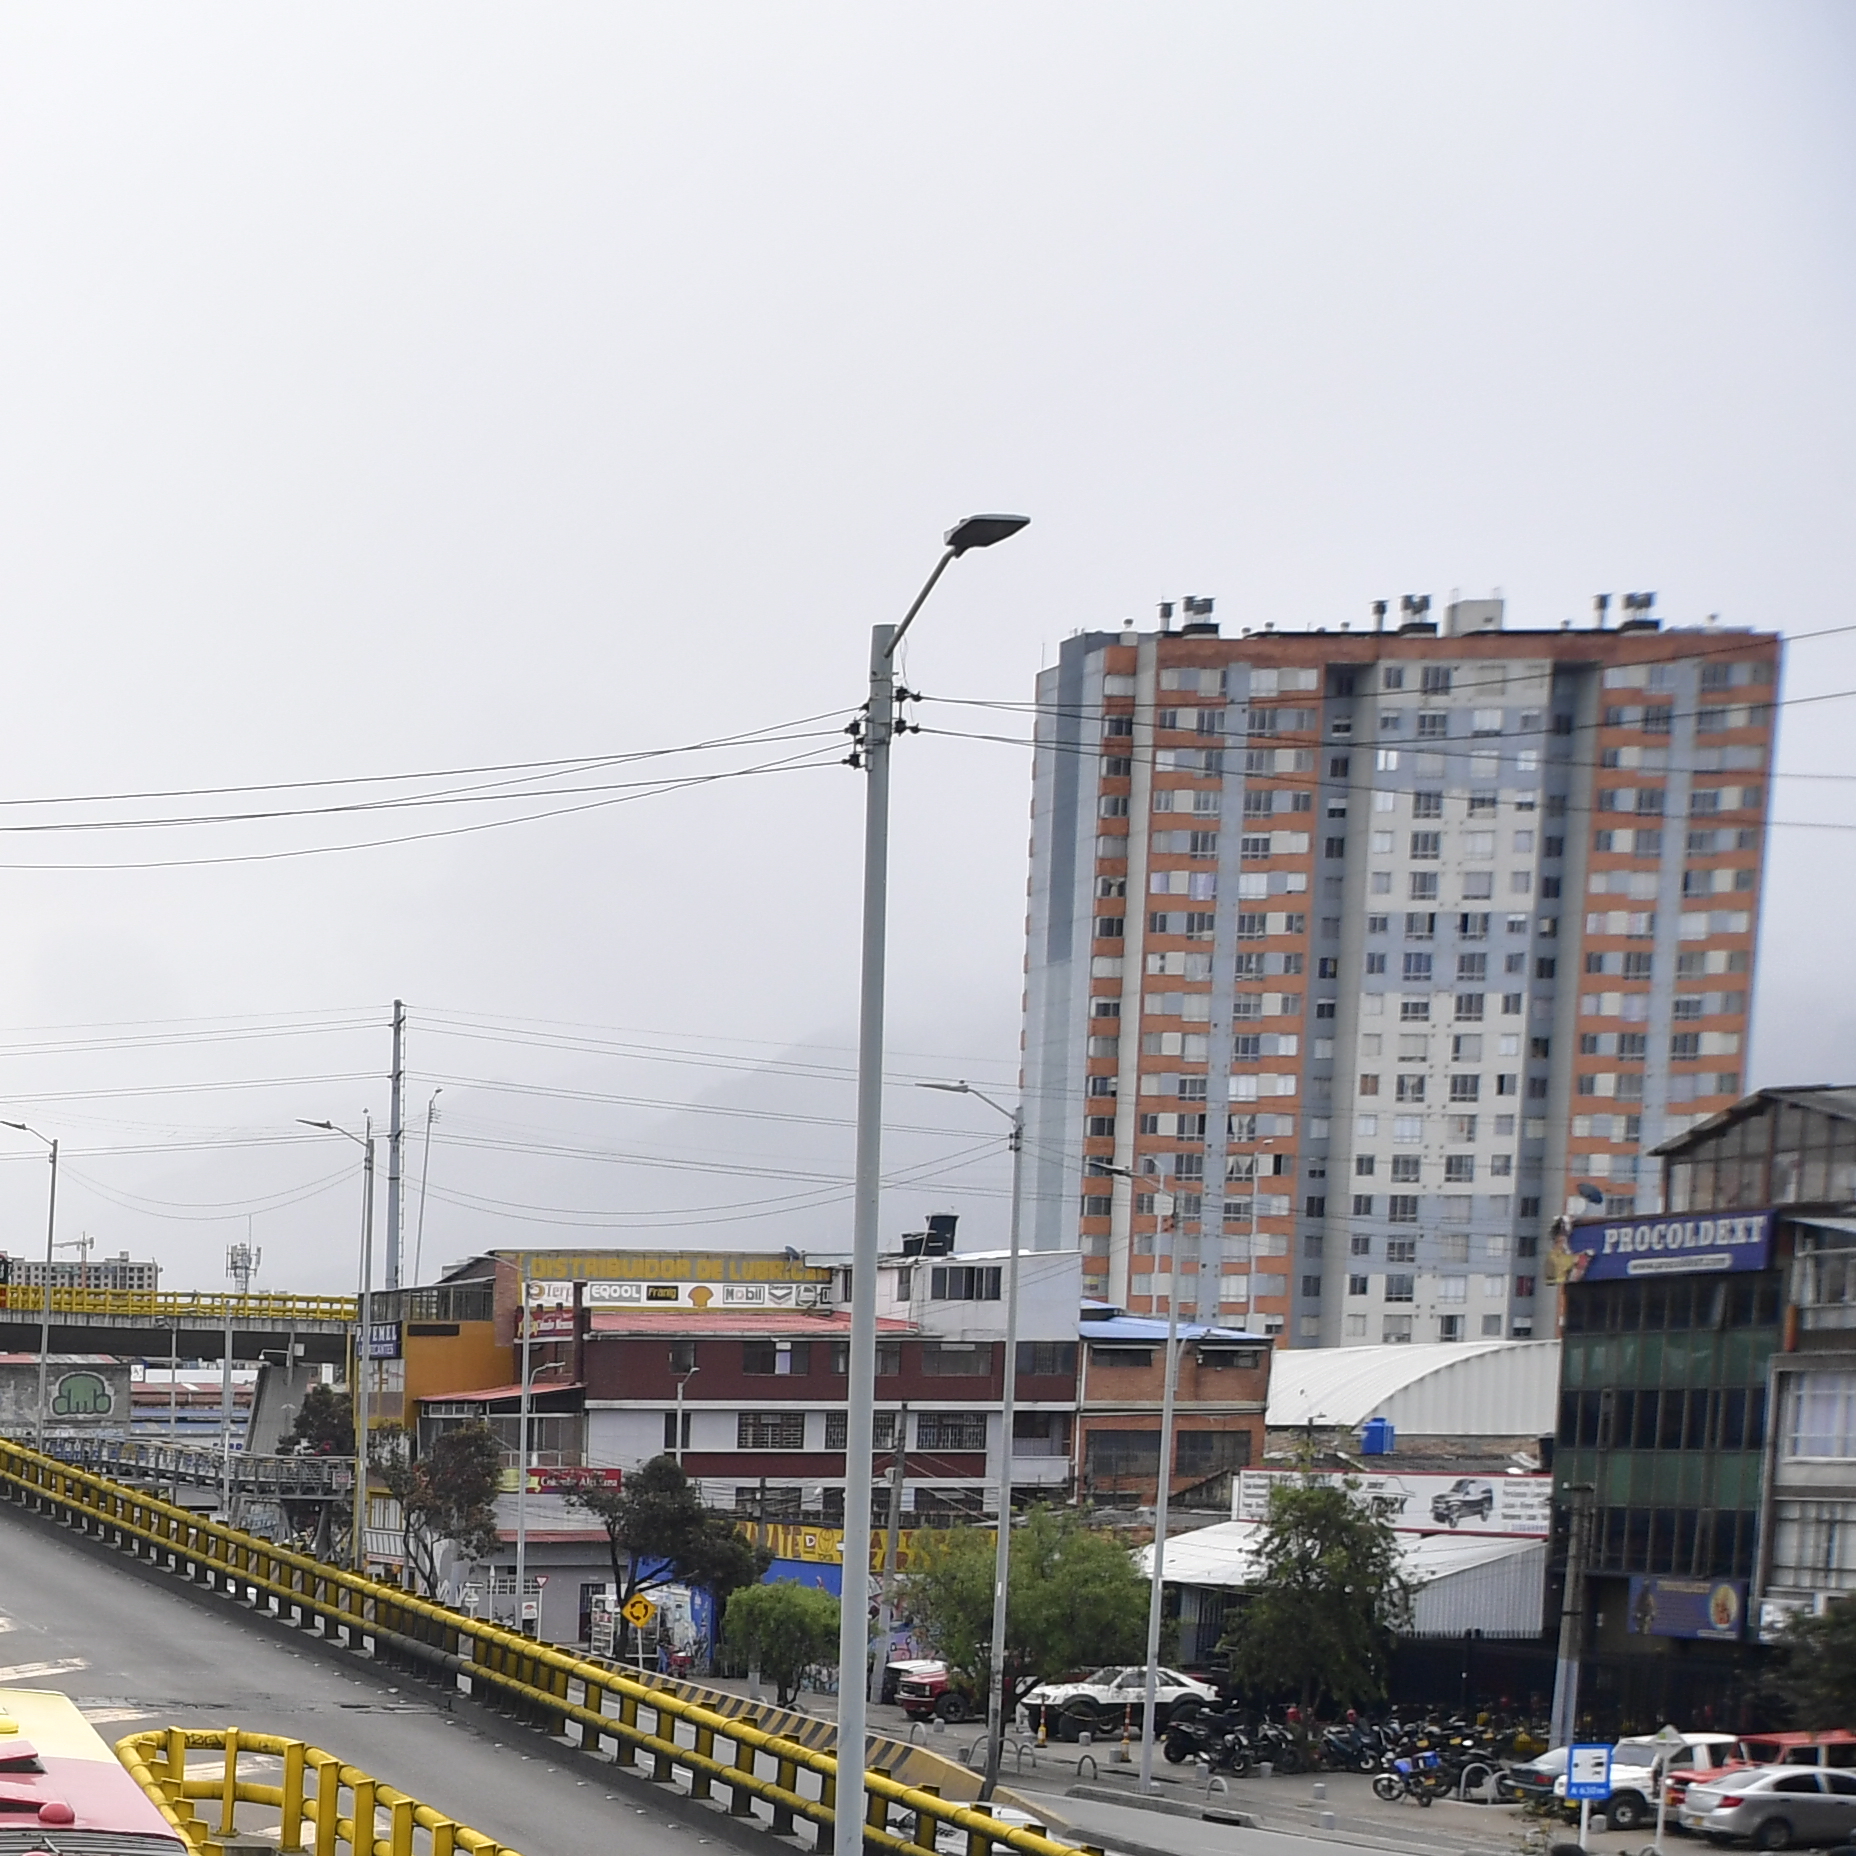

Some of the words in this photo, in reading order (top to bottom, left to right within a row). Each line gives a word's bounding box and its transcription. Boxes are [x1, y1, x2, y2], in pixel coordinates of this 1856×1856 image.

[531, 1257, 691, 1279] DISTRIBUIDOR
[697, 1258, 723, 1279] DE
[725, 1287, 762, 1302] Mobil
